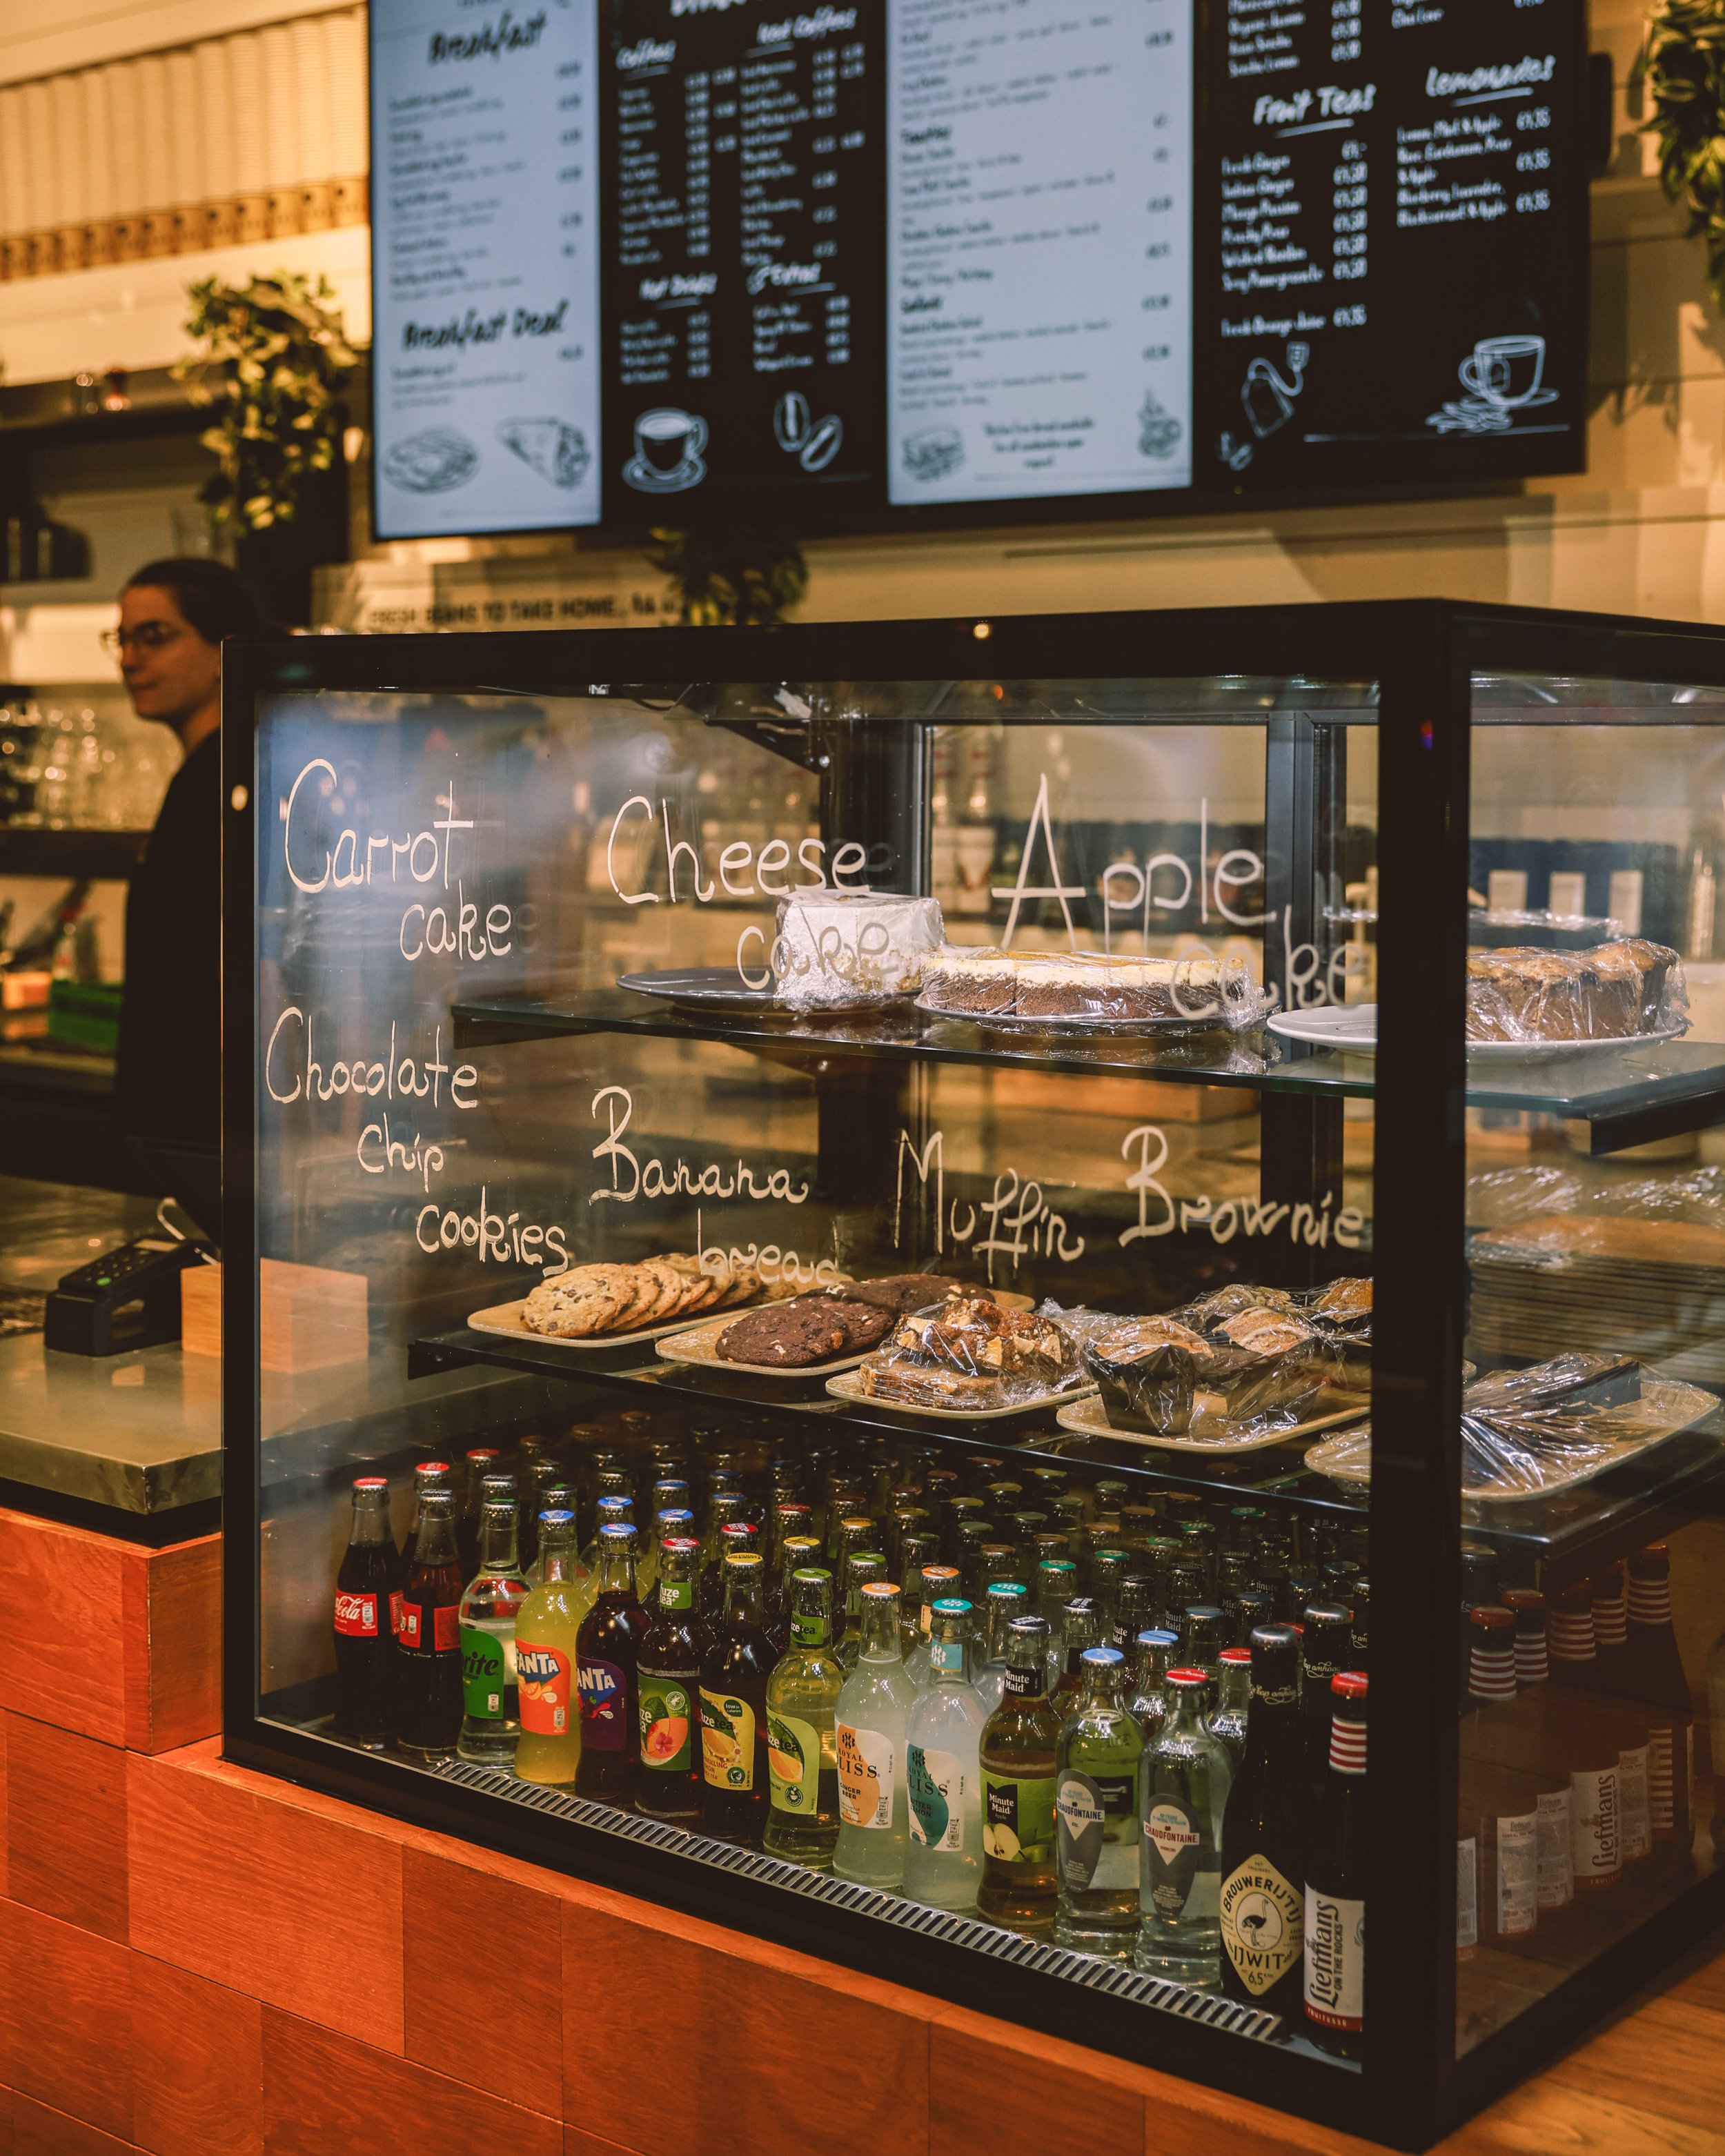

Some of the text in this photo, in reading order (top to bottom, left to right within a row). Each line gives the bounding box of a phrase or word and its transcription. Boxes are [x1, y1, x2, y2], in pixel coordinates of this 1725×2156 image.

[429, 10, 547, 64] Breakfast
[1426, 55, 1555, 97] Lemonades
[1254, 83, 1377, 125] Fruit Teas
[401, 308, 507, 354] Breakfast
[512, 296, 569, 339] Deal
[285, 758, 473, 893] Carrot
[607, 795, 870, 904] Cheese
[992, 773, 1277, 973] Apple
[400, 879, 512, 961] cake
[736, 907, 898, 990] cake
[1170, 904, 1368, 1021] cake
[266, 1007, 478, 1109] Chocolate
[589, 1085, 809, 1205] Banana
[894, 1129, 1085, 1284] Muffin
[1119, 1125, 1368, 1248] Brownie
[697, 1207, 840, 1285] bread
[464, 1651, 499, 1677] rite
[842, 1790, 856, 1800] BEER
[989, 1793, 1014, 1807] Minute
[992, 1803, 1010, 1814] Maid
[1057, 1801, 1102, 1820] CHAUDFONTAINE
[1145, 1824, 1197, 1843] CHAUDFONTAINE
[1591, 1774, 1617, 1868] Liefmans
[1310, 1900, 1339, 2009] Liefmans
